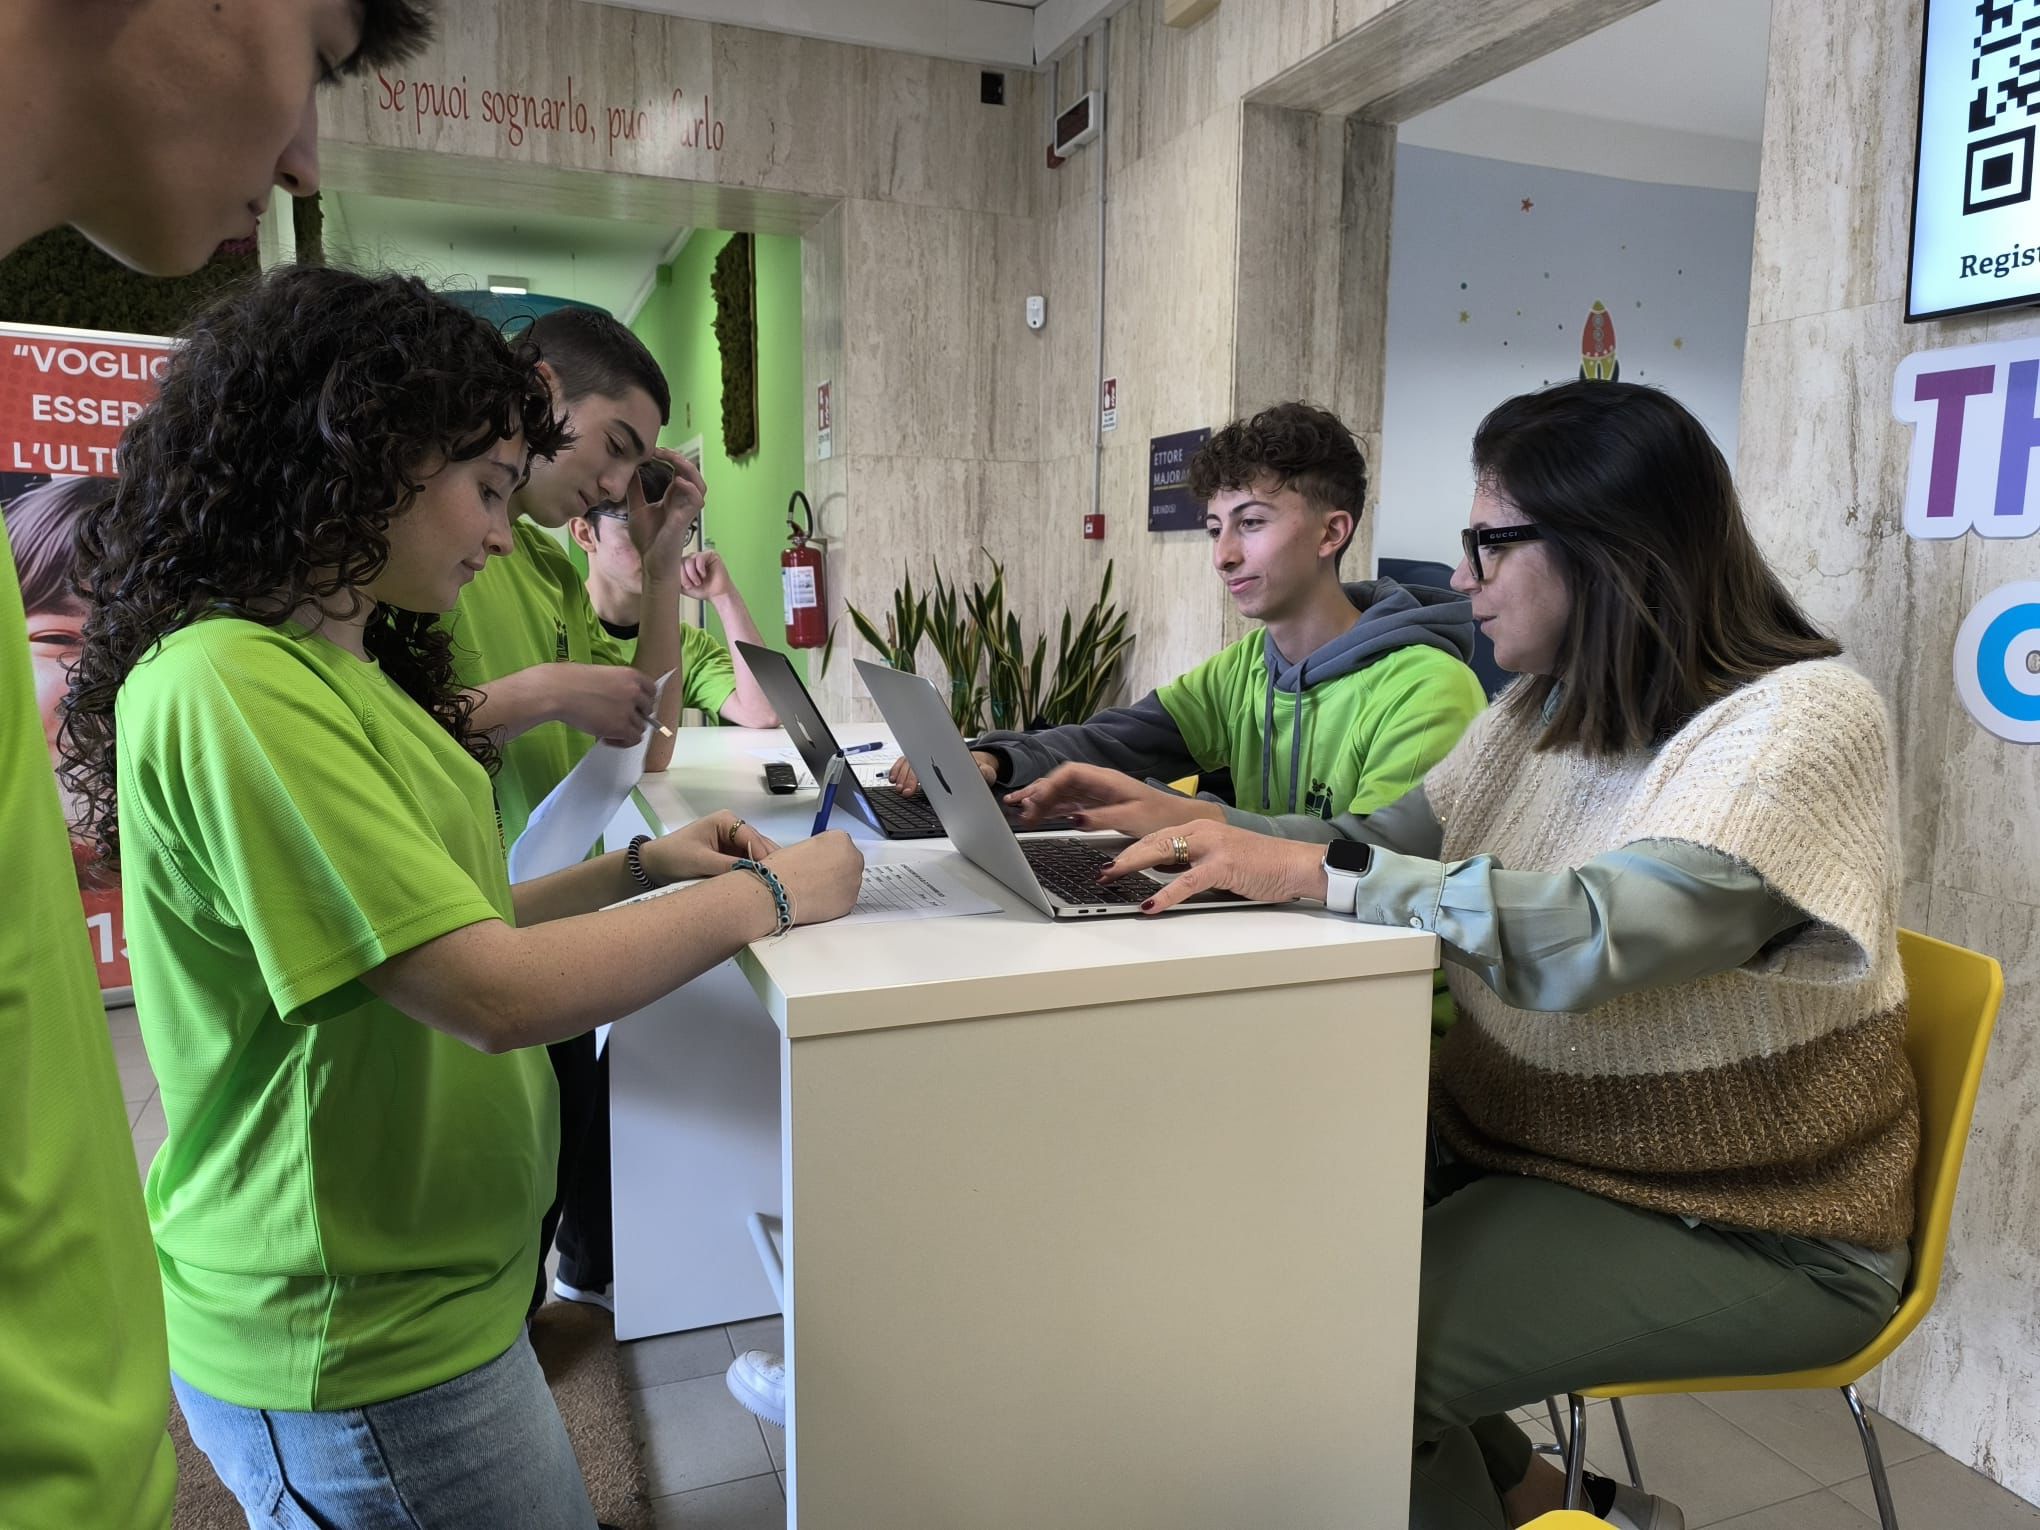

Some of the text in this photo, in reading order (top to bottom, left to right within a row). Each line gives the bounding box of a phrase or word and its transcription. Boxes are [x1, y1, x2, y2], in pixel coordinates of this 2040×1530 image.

[378, 69, 405, 112] Se
[412, 75, 470, 135] puoi
[482, 75, 595, 146] sognarlo,
[607, 99, 655, 157] puo
[1959, 243, 2040, 279] Regis
[32, 394, 149, 427] ESSER
[1154, 448, 1183, 466] ETTORE
[1489, 531, 1518, 539] GUCCI
